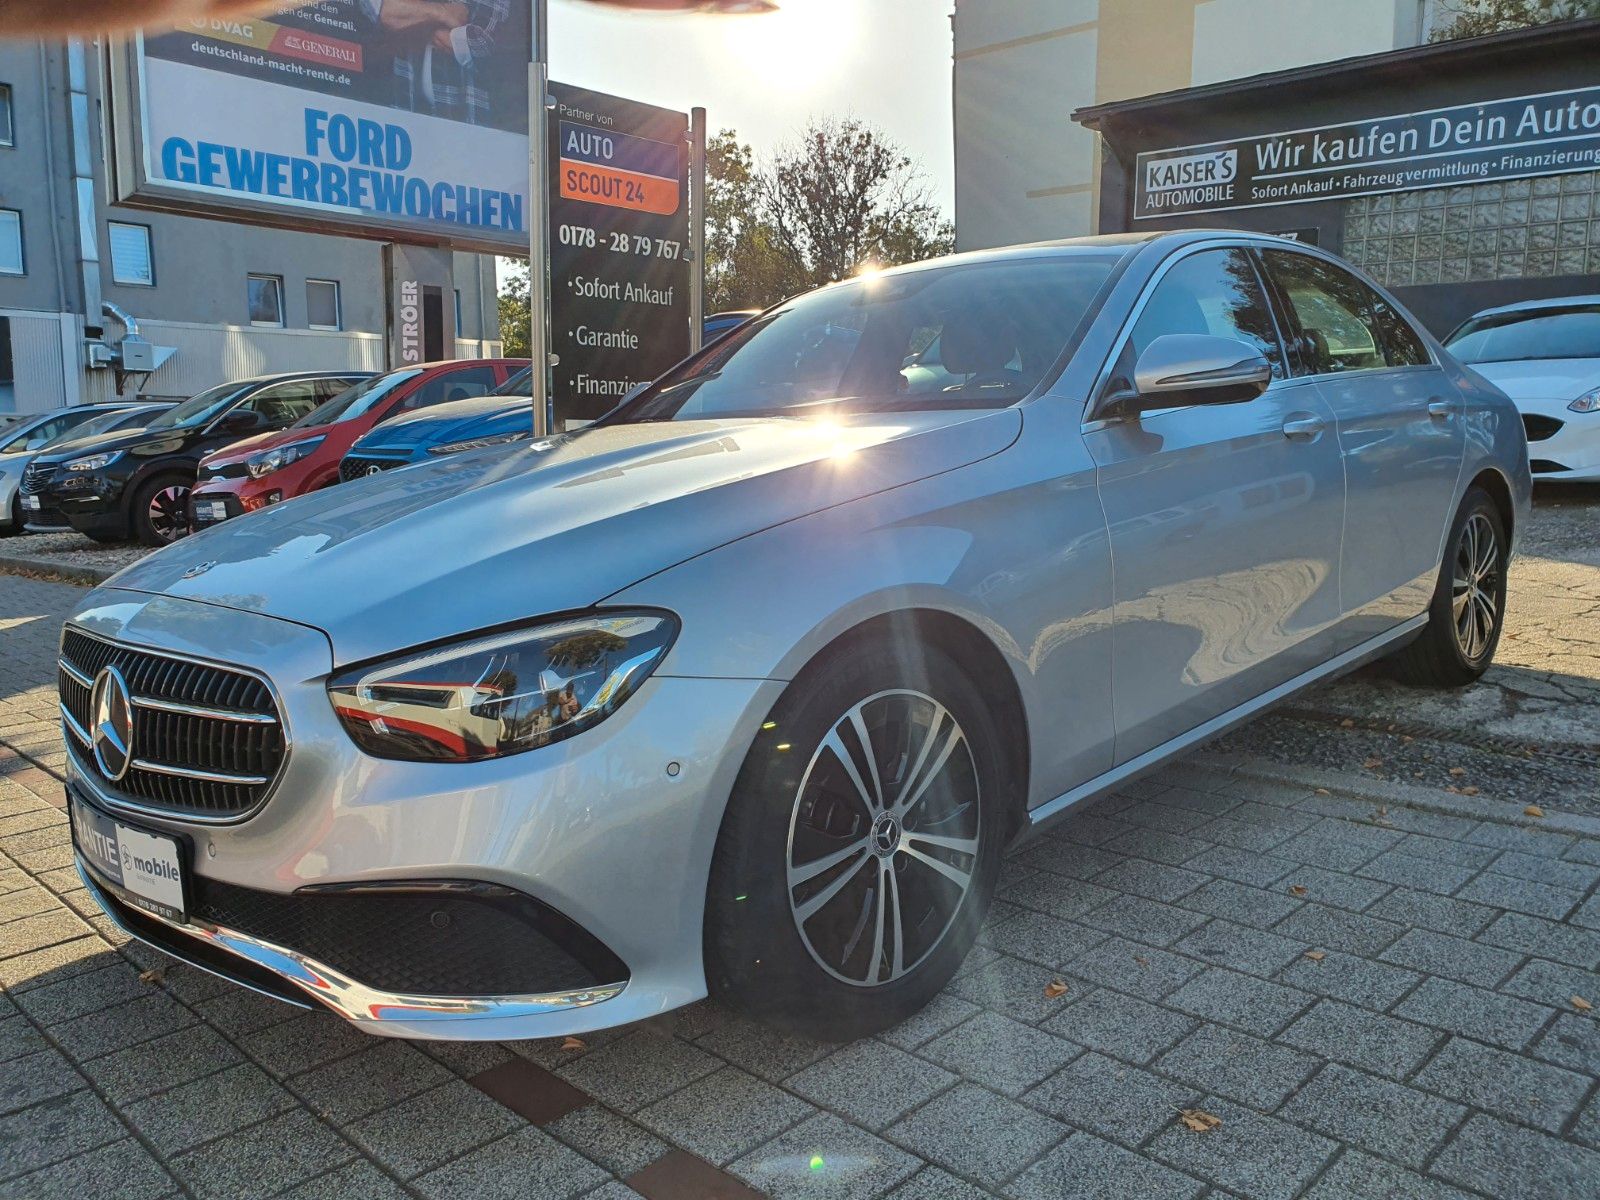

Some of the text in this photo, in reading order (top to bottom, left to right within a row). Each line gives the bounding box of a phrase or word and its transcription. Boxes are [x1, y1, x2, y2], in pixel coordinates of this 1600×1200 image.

[297, 10, 312, 20] der
[191, 41, 351, 86] deutschland-macht-rente.de
[301, 40, 356, 64] GENERALI
[559, 103, 613, 126] Partner von
[304, 107, 412, 171] FORD
[566, 130, 614, 160] AUTO
[1255, 100, 1600, 171] Wir kaufen Dein Auto
[161, 136, 522, 231] GEWERBEWOCHEN
[1251, 149, 1600, 199] Sofort Ankauf Fahrzeugvermittlung Finanzierung
[1145, 184, 1234, 209] AUTOMOBILE
[559, 224, 596, 248] 0178
[609, 232, 630, 253] 28
[633, 235, 651, 256] 79
[655, 238, 681, 260] 767
[575, 276, 674, 306] Sofort Ankauf
[400, 280, 419, 362] STRÖER
[576, 325, 639, 350] Garantie
[577, 374, 640, 396] Finanzie
[133, 855, 179, 882] mobile
